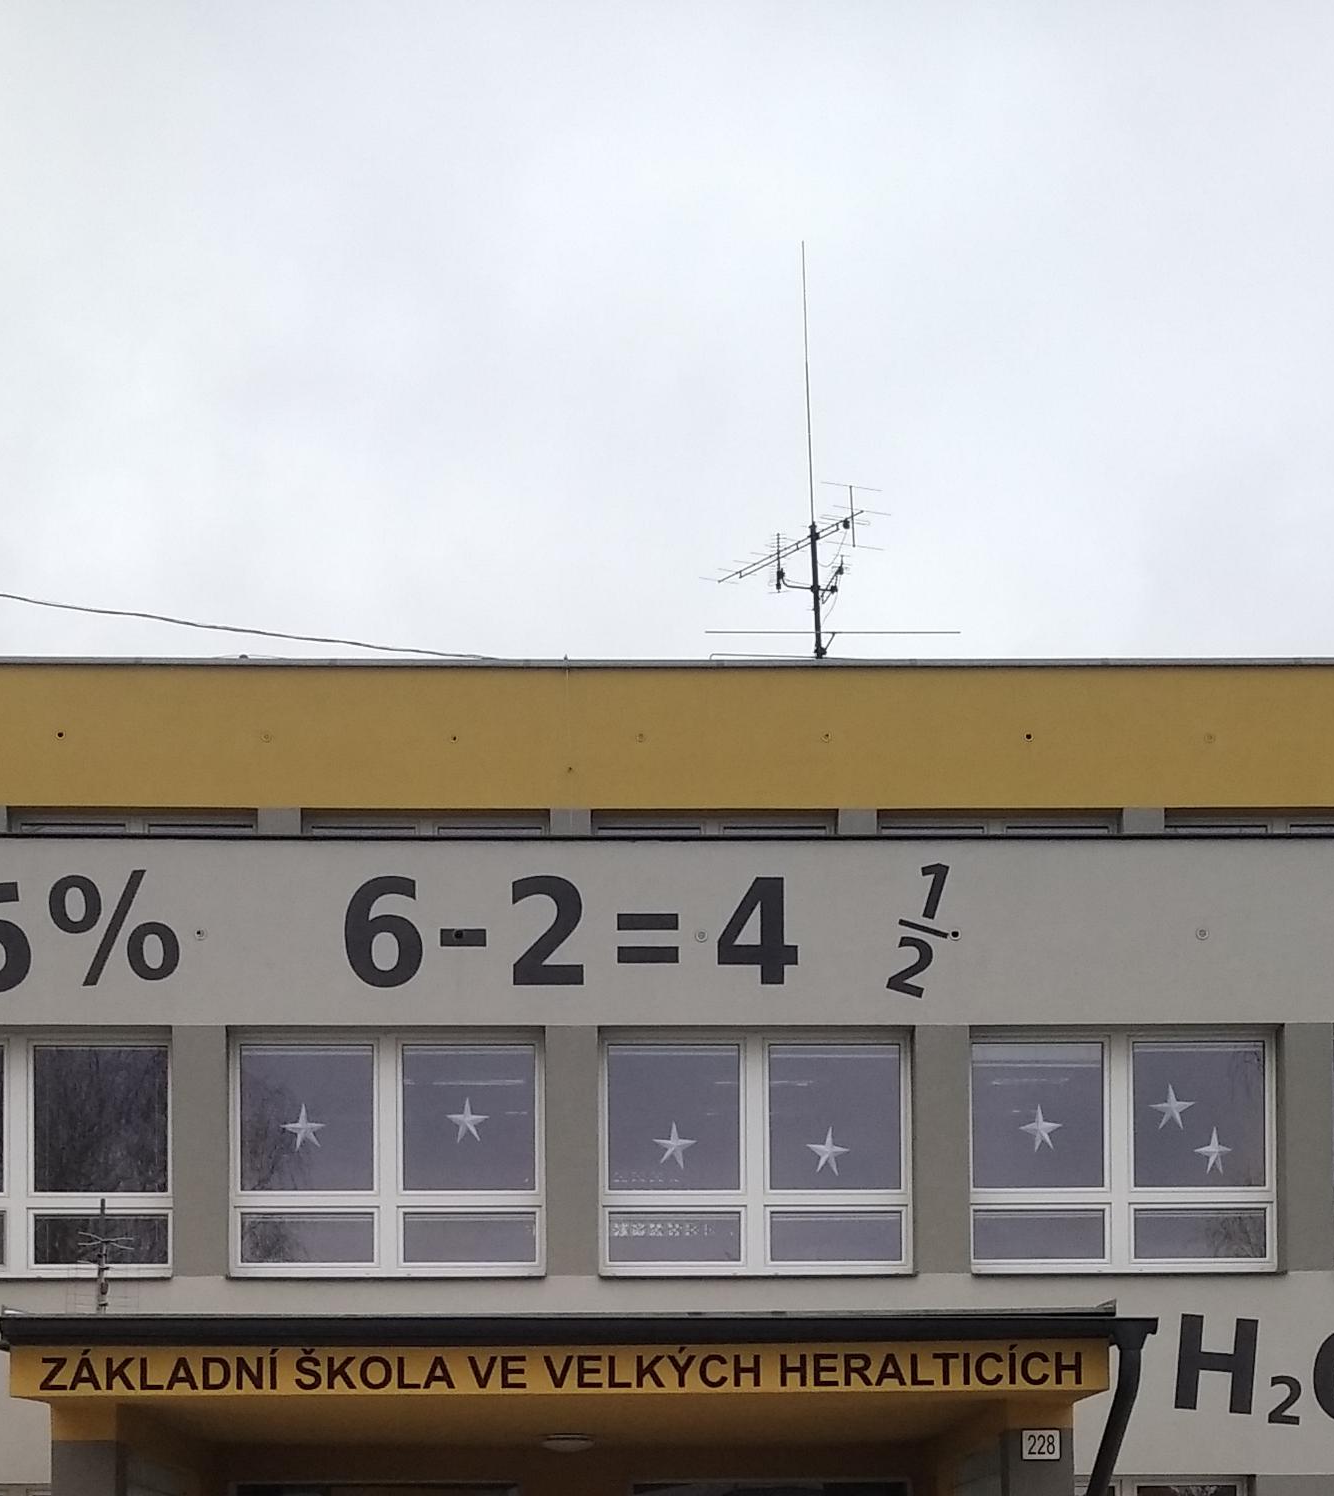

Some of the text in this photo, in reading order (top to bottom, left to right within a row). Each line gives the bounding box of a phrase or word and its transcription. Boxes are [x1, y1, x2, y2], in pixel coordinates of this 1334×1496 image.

[39, 1344, 1083, 1391] ZÁKLADNÍ ŠKOLA VE VELKÝCH HERALTICÍCH
[1027, 1433, 1056, 1456] 228
